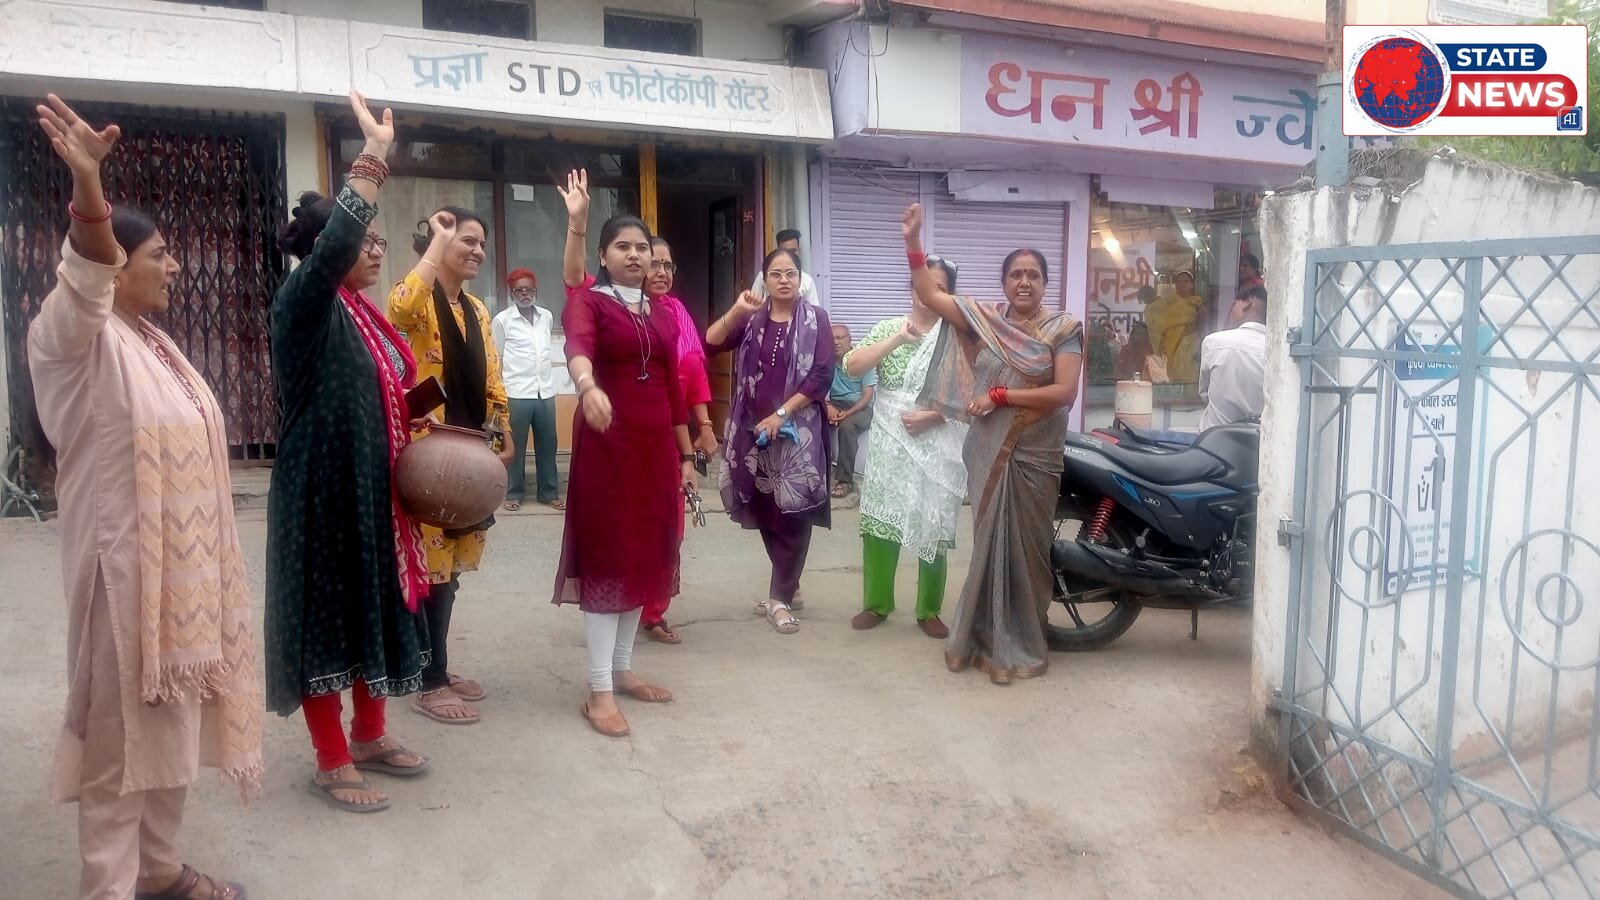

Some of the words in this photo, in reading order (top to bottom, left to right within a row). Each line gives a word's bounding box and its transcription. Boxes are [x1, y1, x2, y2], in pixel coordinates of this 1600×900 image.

[407, 51, 489, 91] प्रज्ञा
[507, 61, 581, 96] STD
[605, 65, 719, 108] फोटोकॉपी
[723, 78, 771, 111] सेंटर
[985, 61, 1110, 130] धन
[1129, 71, 1203, 139] श्री
[1232, 89, 1318, 150] ज्वे
